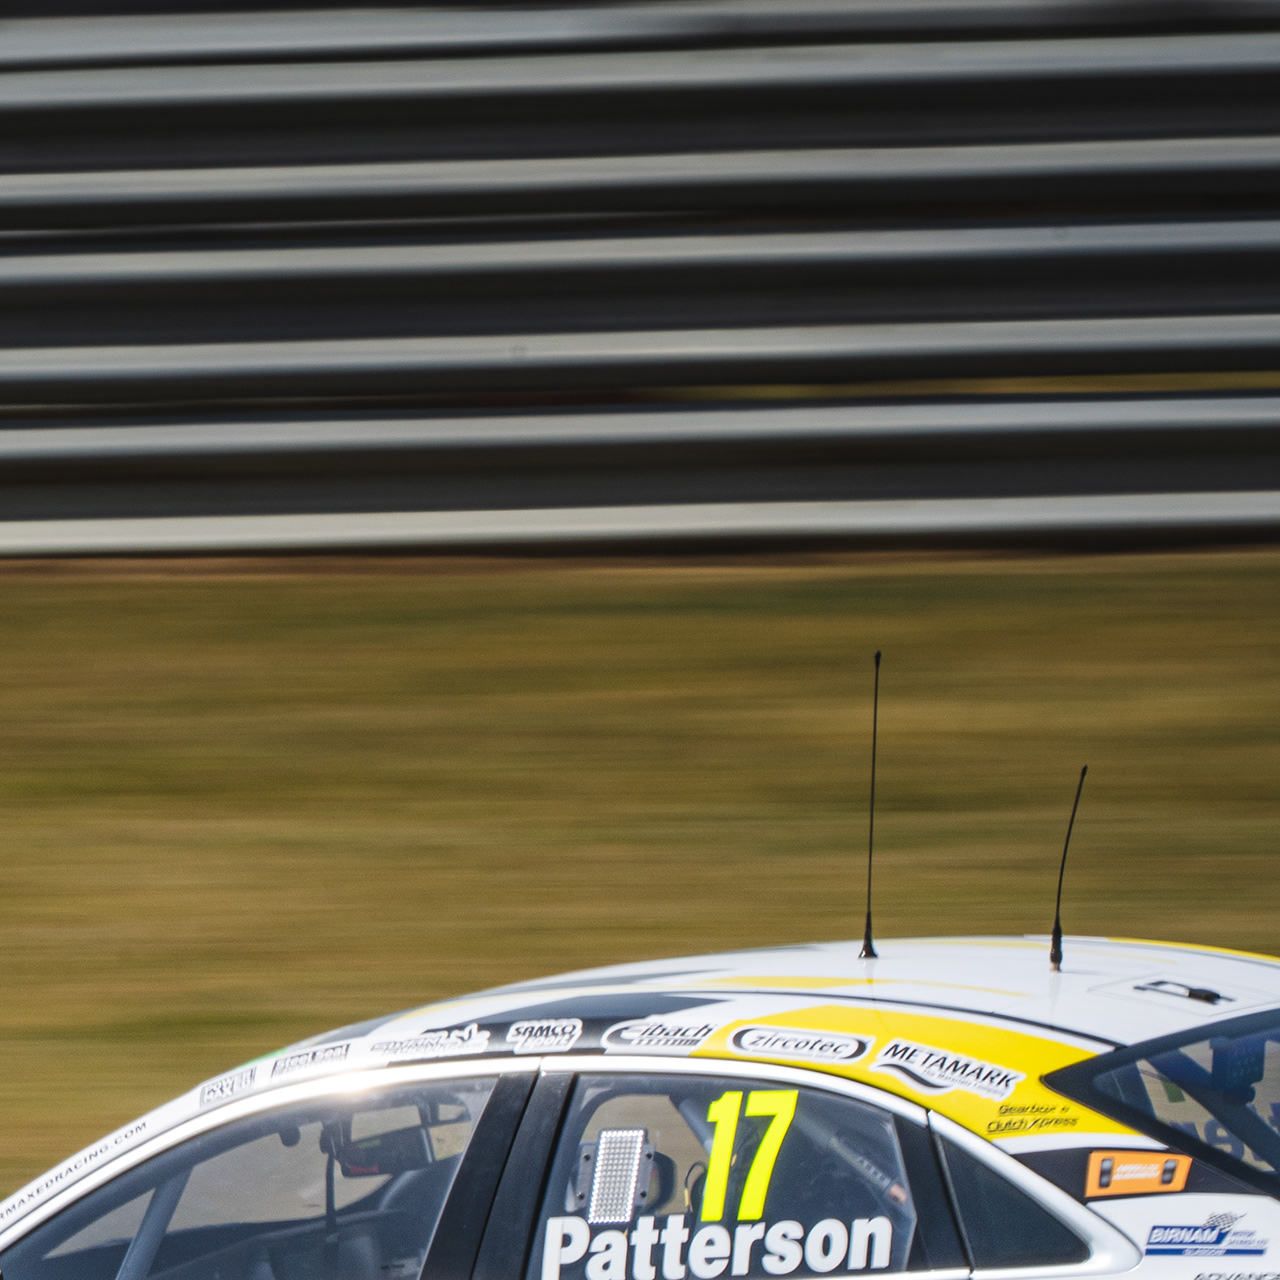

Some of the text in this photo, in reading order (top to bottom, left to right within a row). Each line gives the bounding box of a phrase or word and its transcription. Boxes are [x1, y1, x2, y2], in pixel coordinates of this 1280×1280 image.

[512, 1023, 576, 1037] SAMCO
[750, 1032, 849, 1055] zircotec
[882, 1042, 1020, 1089] METAMARK
[987, 1117, 1029, 1133] Clutch
[701, 1090, 799, 1222] 17
[1149, 1227, 1220, 1244] BIRNAM
